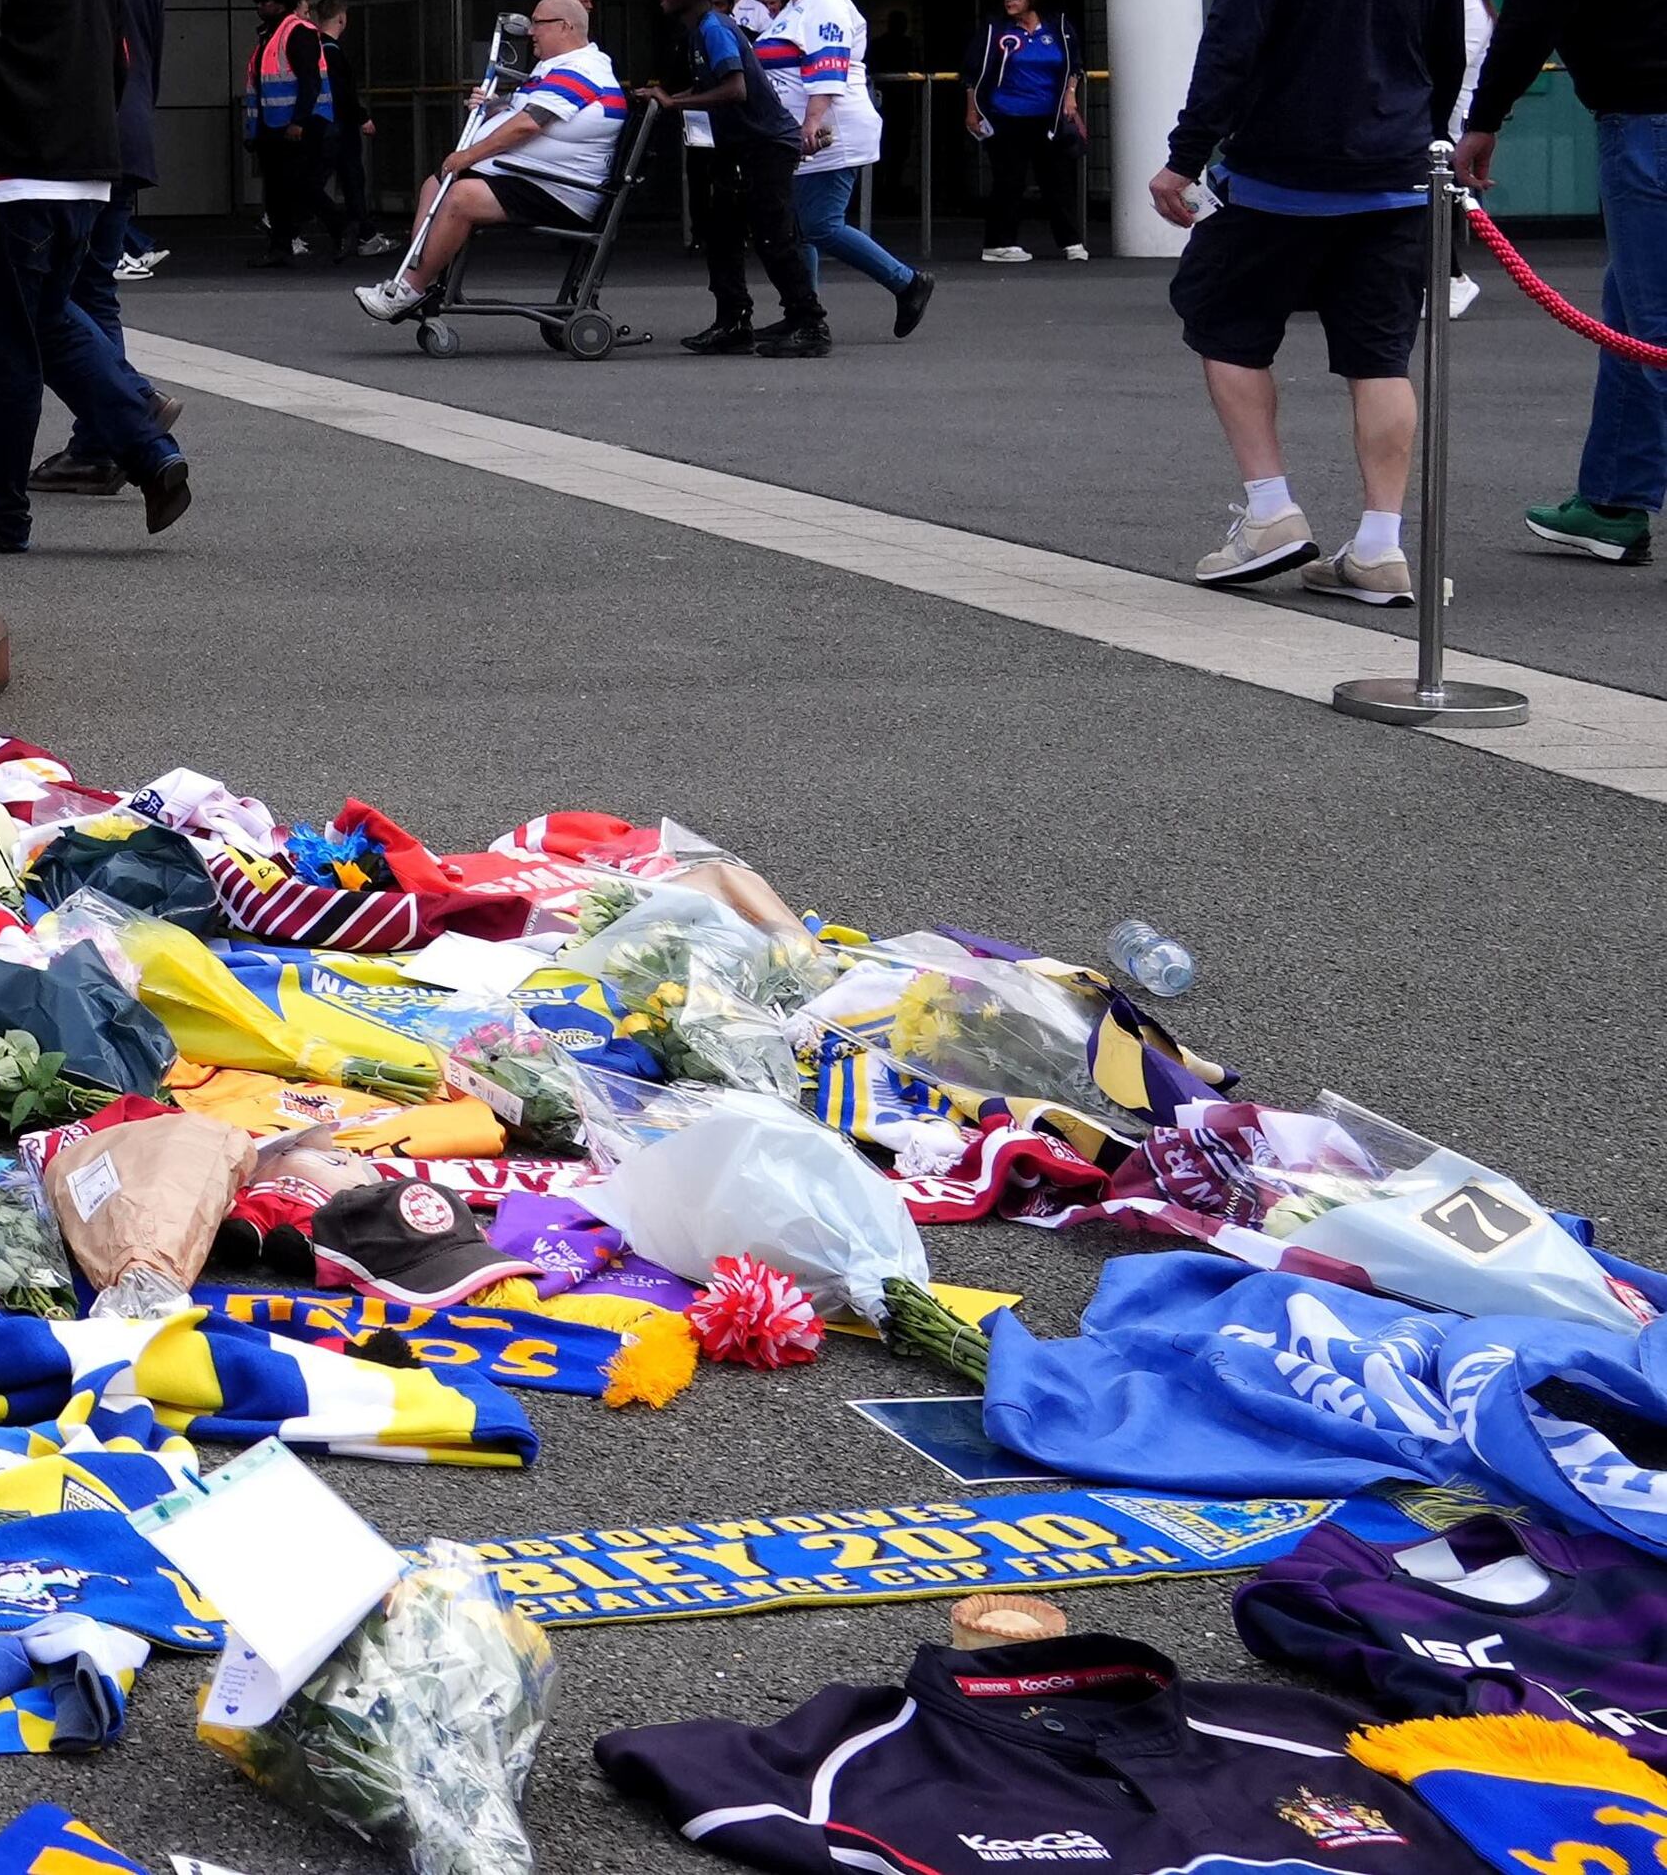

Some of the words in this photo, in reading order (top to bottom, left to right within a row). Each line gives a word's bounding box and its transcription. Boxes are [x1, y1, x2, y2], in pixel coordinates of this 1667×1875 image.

[1435, 1192, 1509, 1243] 7
[695, 1502, 979, 1539] WOLVES
[798, 1513, 1128, 1569] 2010
[513, 1571, 854, 1619] CHALLENGE
[866, 1558, 989, 1588] CUP
[1014, 1543, 1182, 1576] FINAL
[1400, 1632, 1516, 1672] ISC
[1017, 1677, 1075, 1694] KooGa
[956, 1830, 1106, 1857] KooGa
[977, 1849, 1019, 1863] MADE
[1022, 1849, 1053, 1863] FOR
[1053, 1849, 1112, 1863] RUGBY
